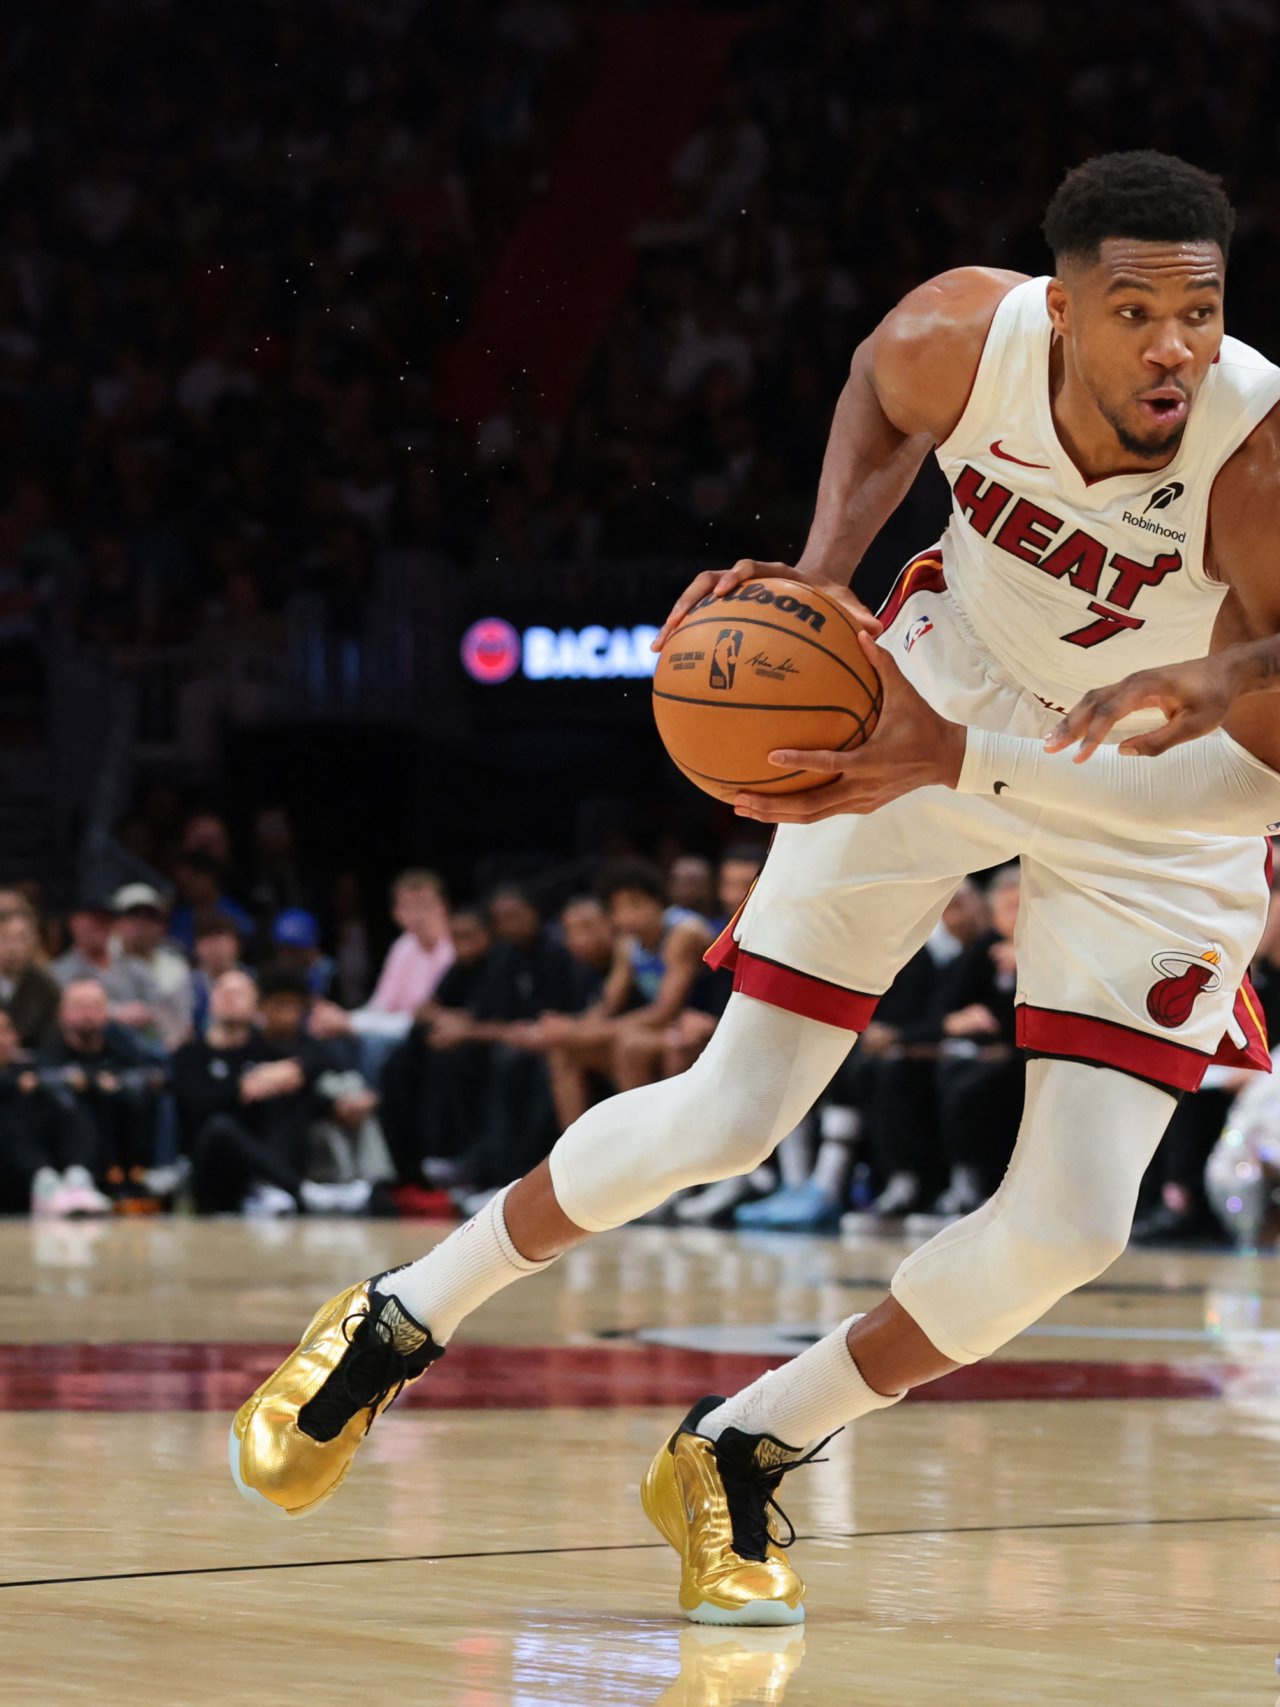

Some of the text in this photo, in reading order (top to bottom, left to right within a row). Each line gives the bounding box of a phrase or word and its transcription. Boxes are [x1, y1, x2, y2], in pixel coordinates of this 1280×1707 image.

[952, 463, 1183, 611] HEAT
[1122, 511, 1186, 543] Robinhood
[1059, 600, 1146, 649] 7
